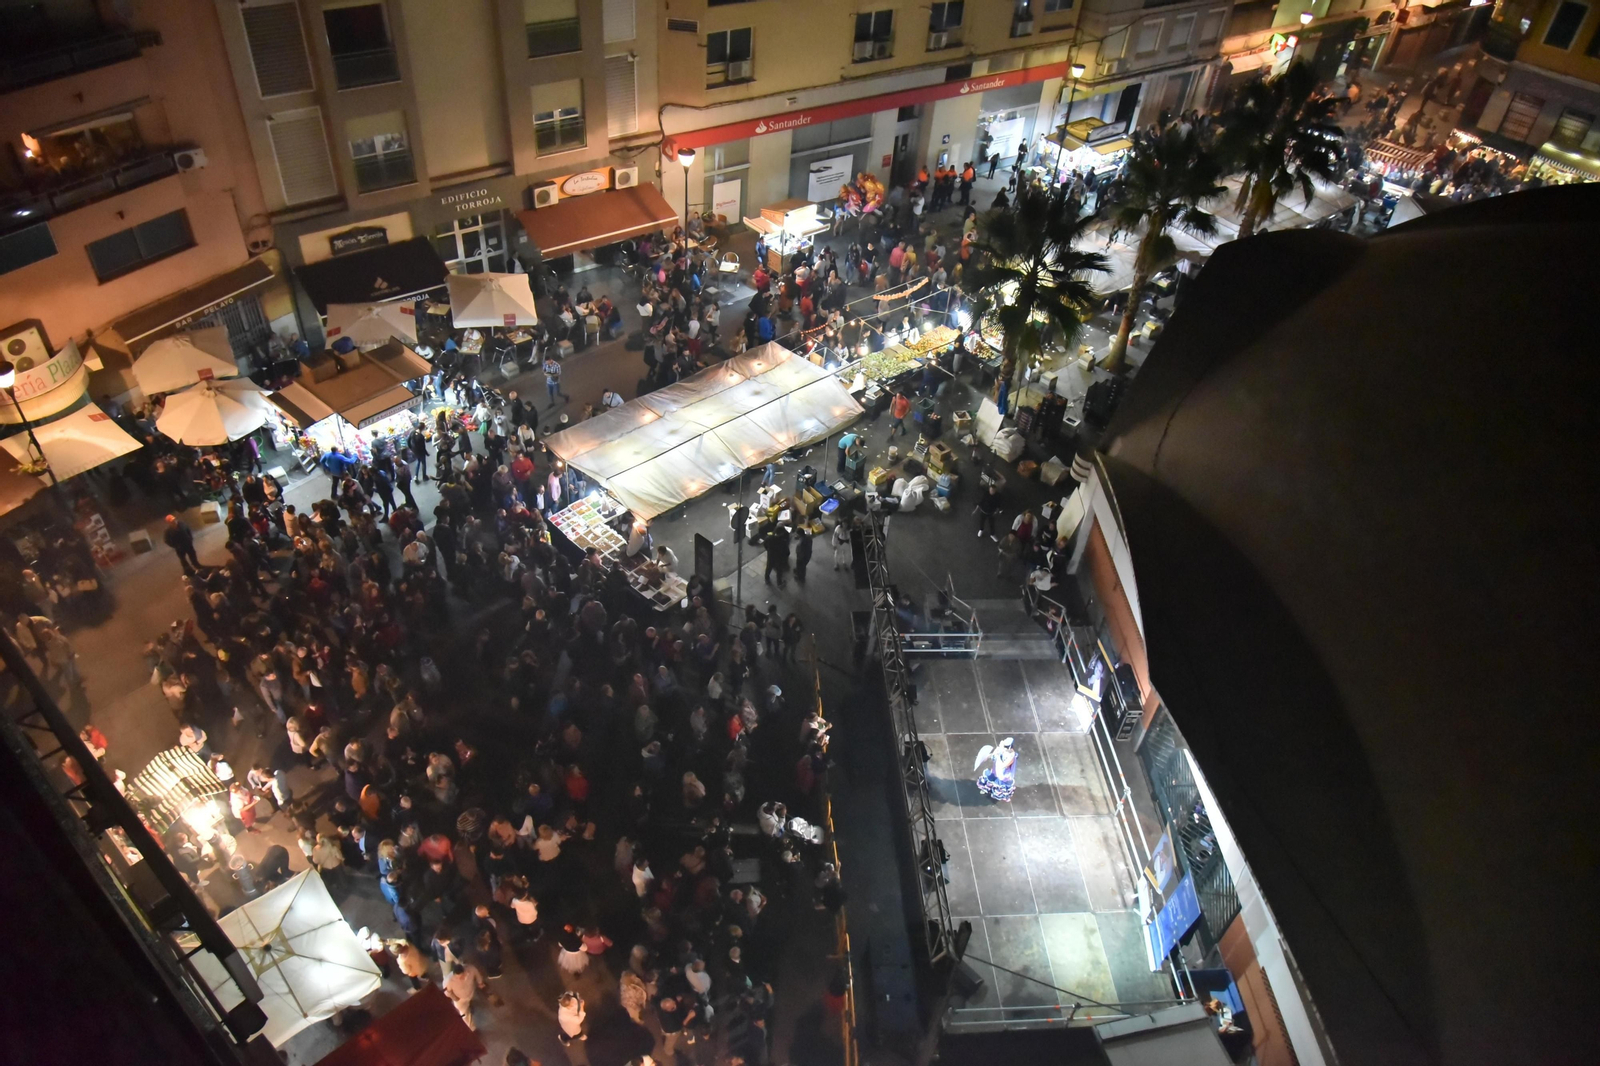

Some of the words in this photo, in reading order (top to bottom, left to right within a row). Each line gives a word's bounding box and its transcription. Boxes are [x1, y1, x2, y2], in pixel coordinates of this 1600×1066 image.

[971, 78, 1006, 92] Santander
[768, 114, 812, 131] Santander
[441, 188, 488, 205] EDIFICIO
[455, 196, 502, 212] TORROJA
[175, 317, 193, 329] BAR
[203, 297, 234, 316] PELAYO
